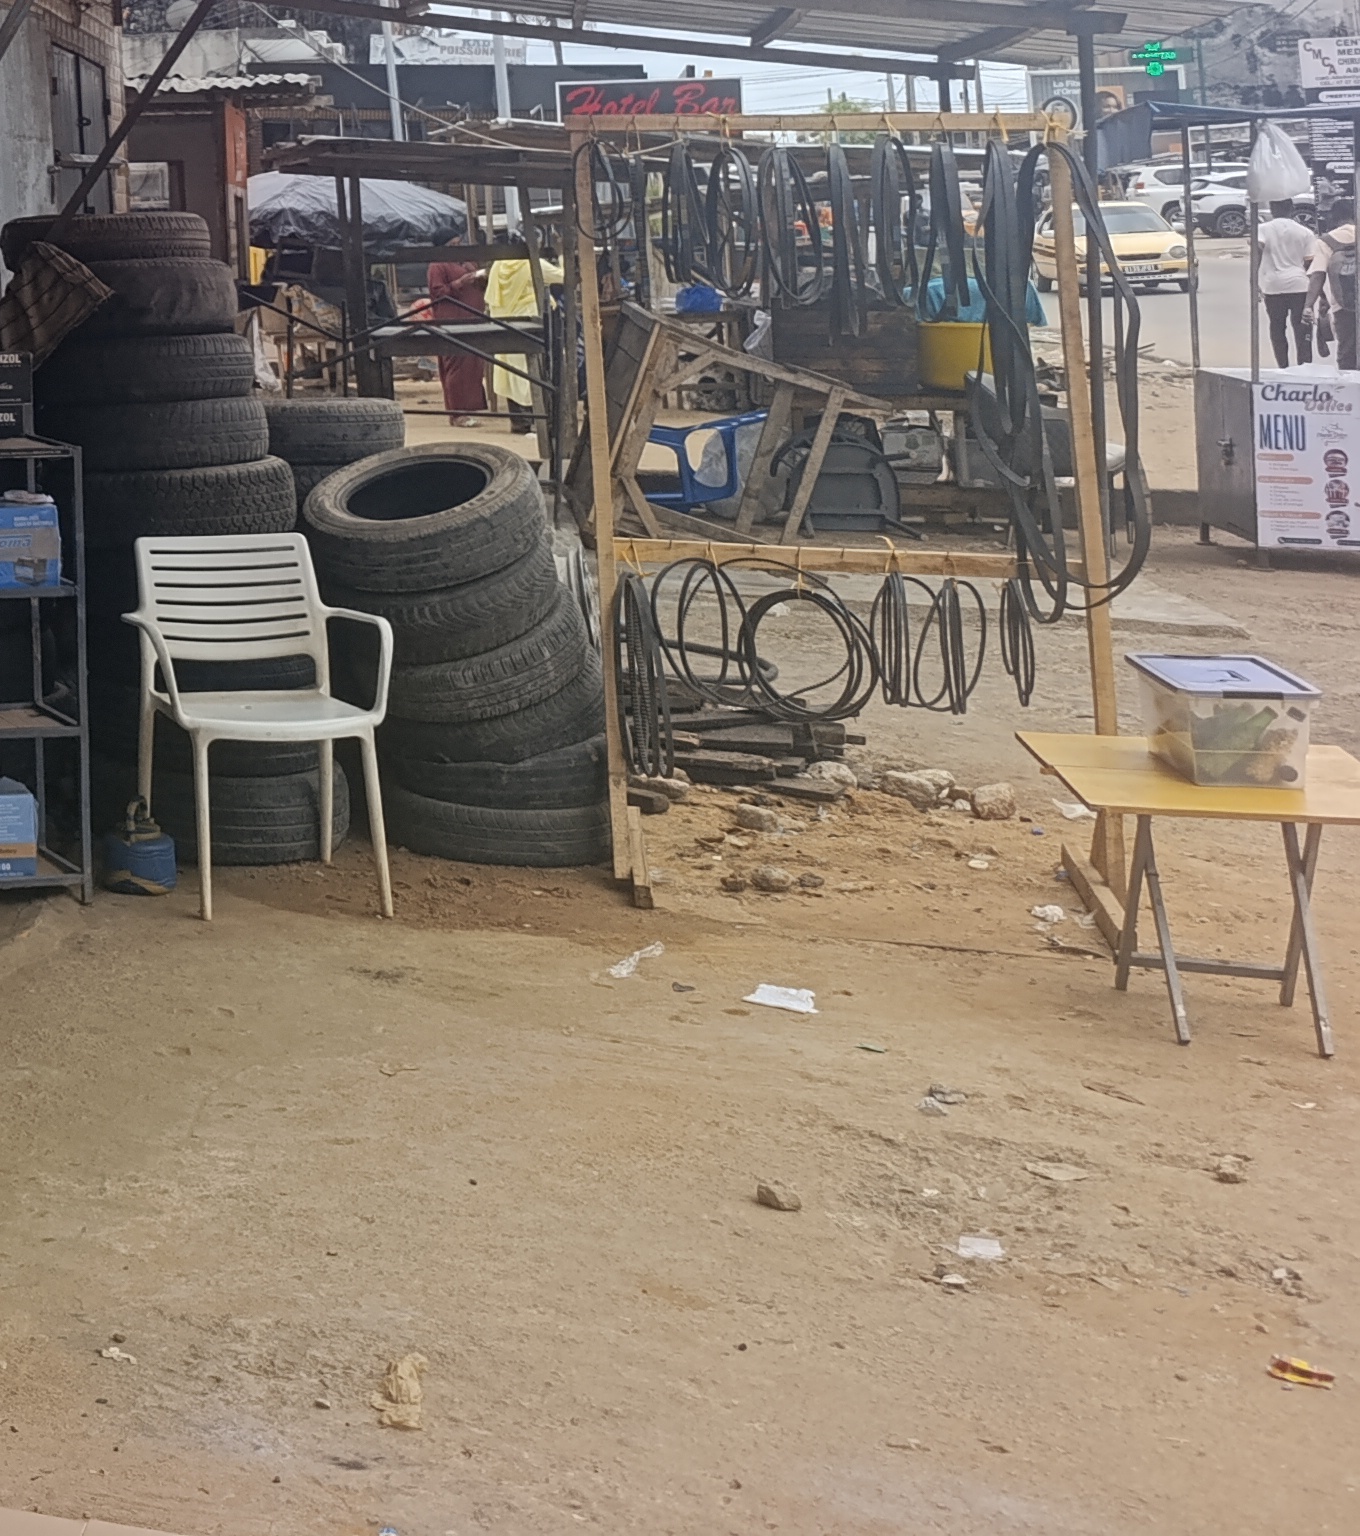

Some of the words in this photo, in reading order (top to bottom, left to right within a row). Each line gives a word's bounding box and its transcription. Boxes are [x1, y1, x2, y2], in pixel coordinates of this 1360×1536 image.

[440, 44, 523, 58] POISSONRIE
[566, 86, 660, 115] Hotel
[673, 82, 737, 115] Bar
[1261, 383, 1331, 402] Charlo
[1259, 414, 1306, 451] MENU
